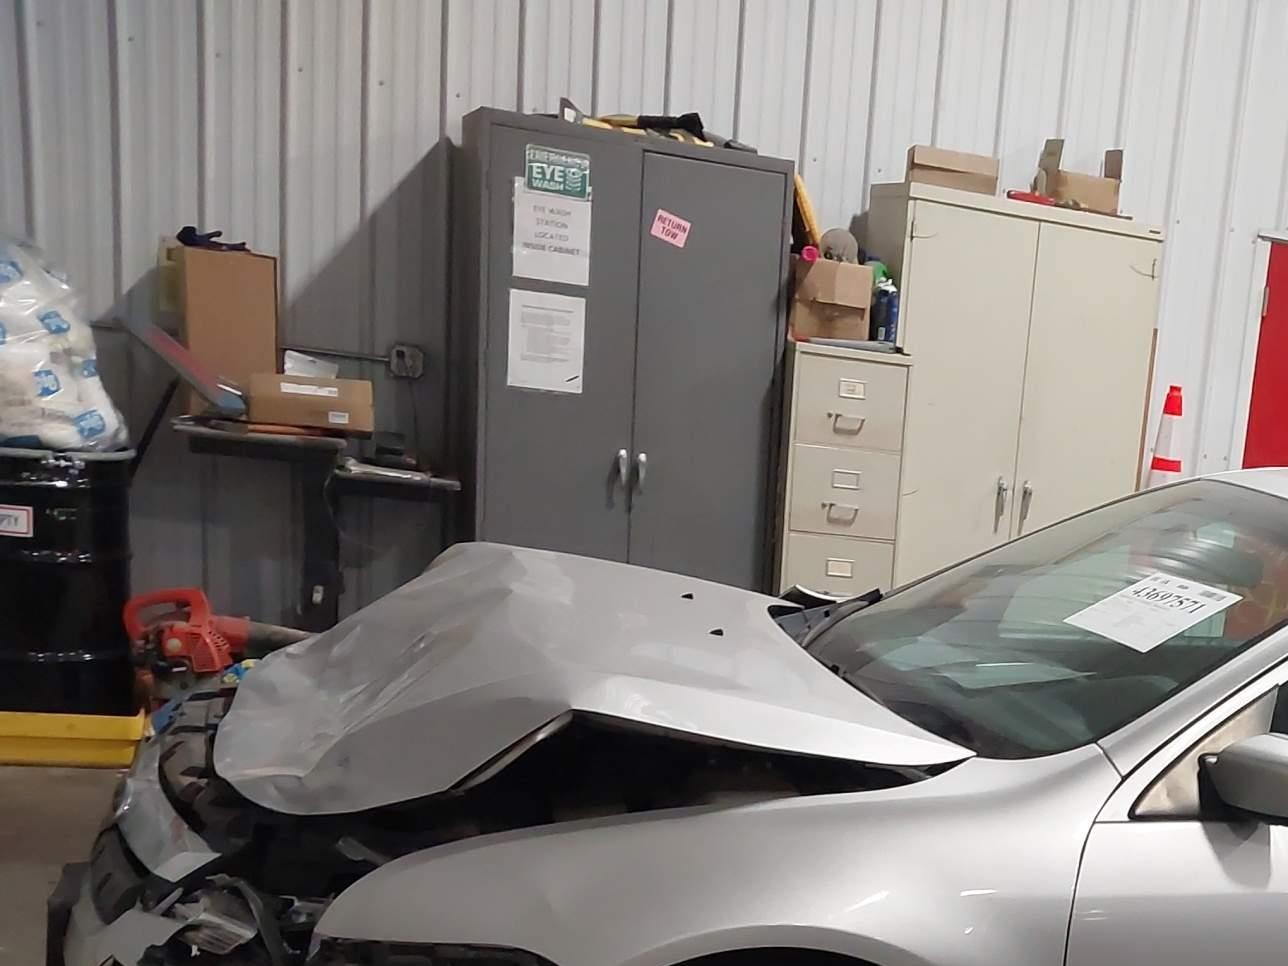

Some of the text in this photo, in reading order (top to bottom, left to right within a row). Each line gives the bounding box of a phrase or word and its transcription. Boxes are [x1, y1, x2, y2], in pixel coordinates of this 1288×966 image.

[532, 164, 565, 182] EYE
[532, 178, 565, 191] WASH
[658, 214, 688, 234] RETURN
[661, 226, 679, 240] TOW
[1131, 586, 1207, 615] 43697571
